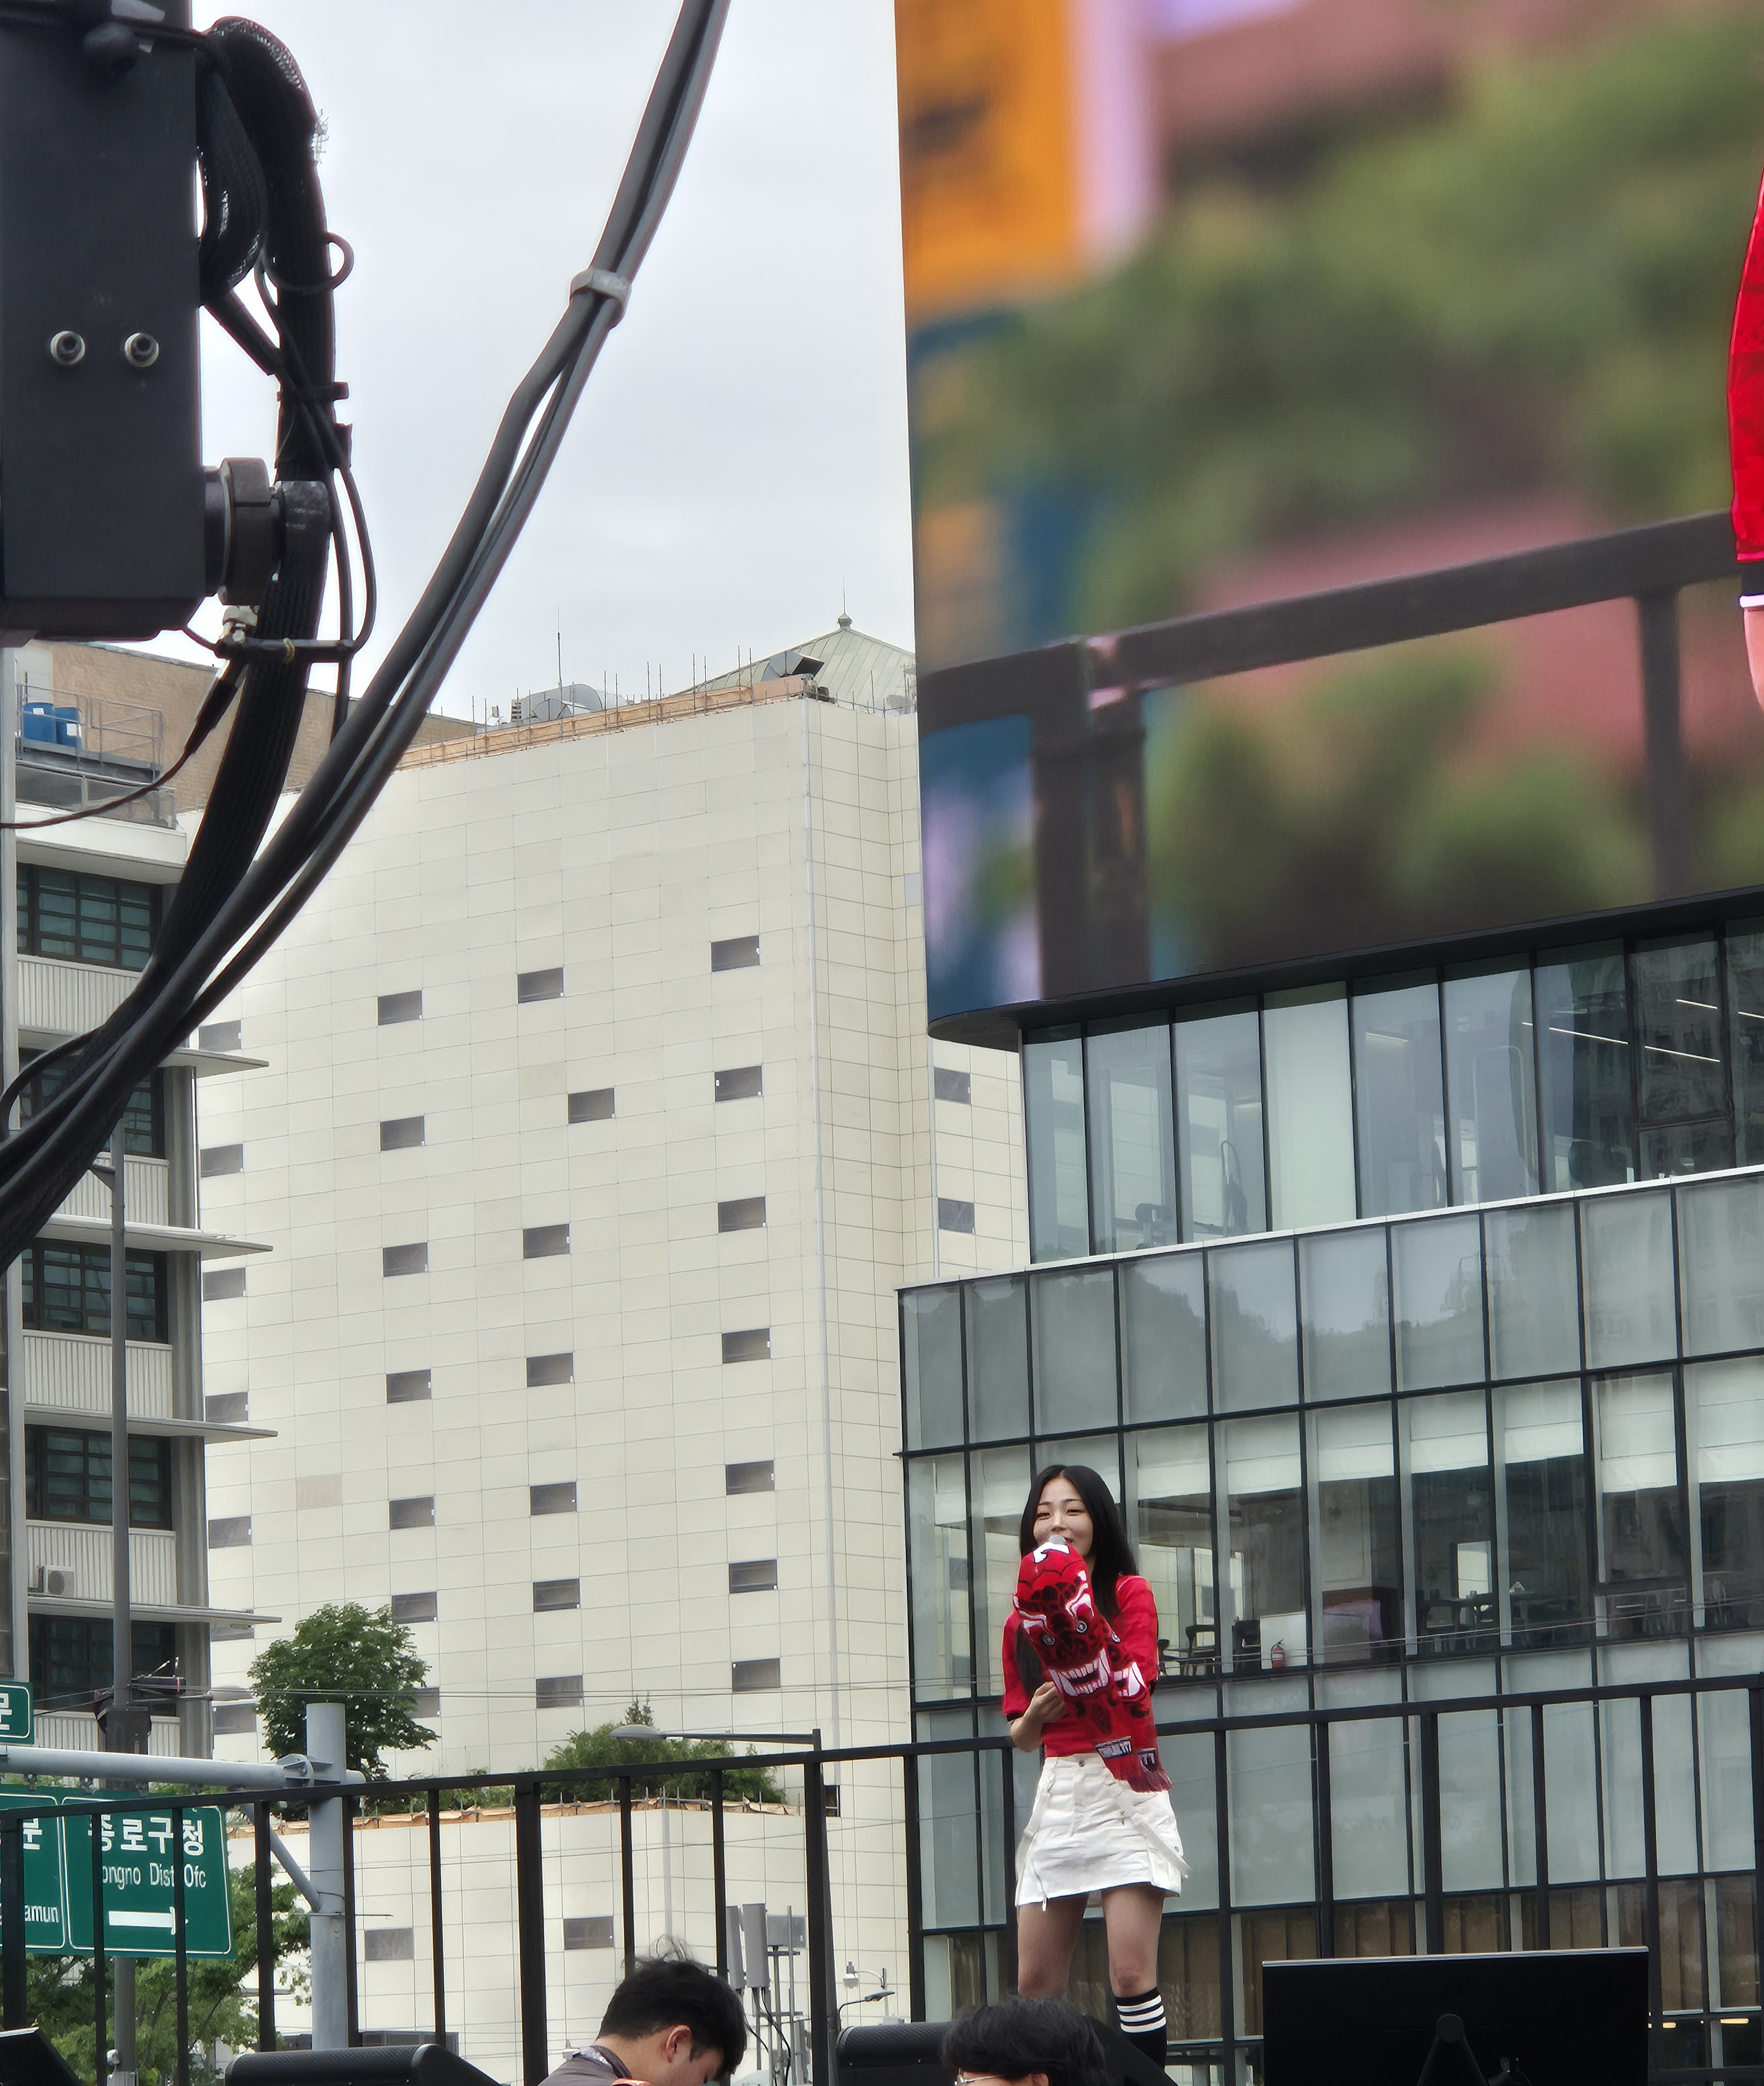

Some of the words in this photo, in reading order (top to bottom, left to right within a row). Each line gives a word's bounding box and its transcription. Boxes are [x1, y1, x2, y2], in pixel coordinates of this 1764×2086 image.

[101, 1866, 142, 1890] ongno
[183, 1863, 206, 1888] Ofc
[24, 1904, 59, 1923] amun
